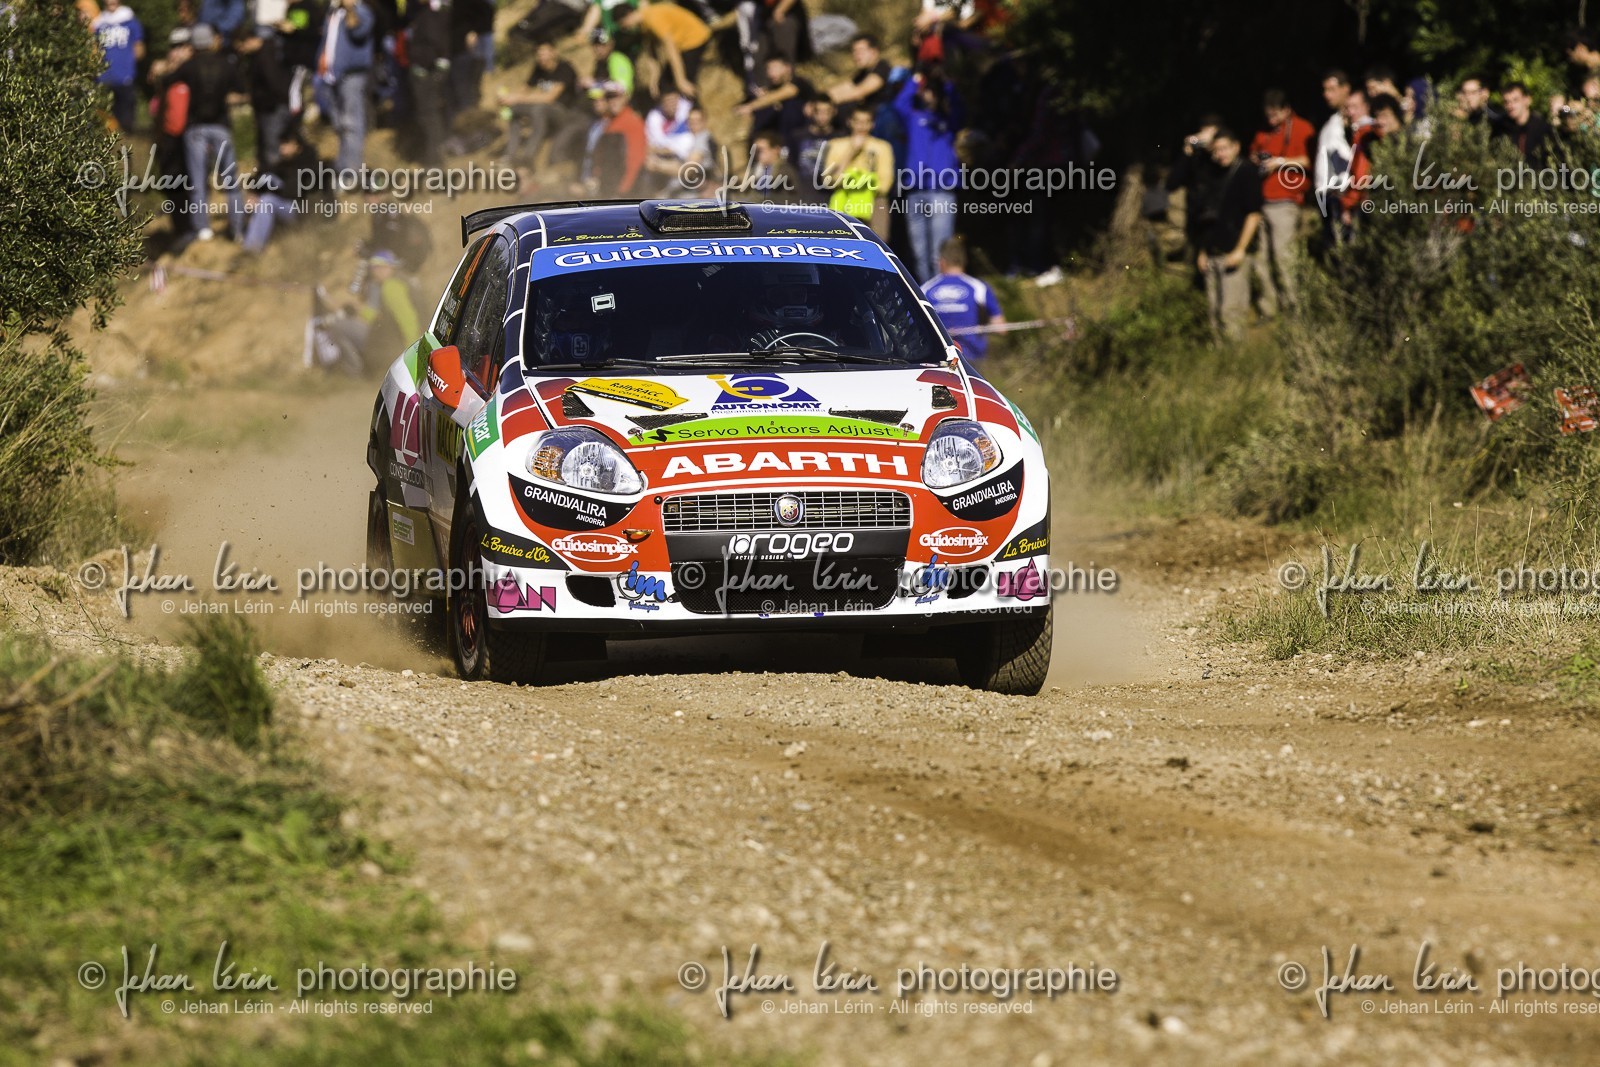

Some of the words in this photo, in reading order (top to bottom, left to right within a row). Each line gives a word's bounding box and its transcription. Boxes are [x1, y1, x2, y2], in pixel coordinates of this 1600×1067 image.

[554, 242, 866, 267] Guidosimplex
[711, 402, 822, 411] AUTONOMY
[679, 428, 739, 438] Servo
[746, 424, 820, 435] Motors
[827, 425, 894, 437] Adjust
[661, 451, 909, 479] ABARTH
[524, 485, 608, 520] GRANDVALIRA
[952, 480, 1015, 511] GRANDVALIRA
[994, 492, 1017, 506] ANDORRA
[576, 513, 606, 528] ANDORRA
[481, 533, 490, 548] La
[490, 536, 524, 557] Bruixa
[525, 544, 550, 564] d'Or
[551, 539, 639, 554] Guidosimplex
[727, 532, 855, 560] progeo
[919, 533, 989, 548] Guidosimplex
[1003, 542, 1018, 559] La
